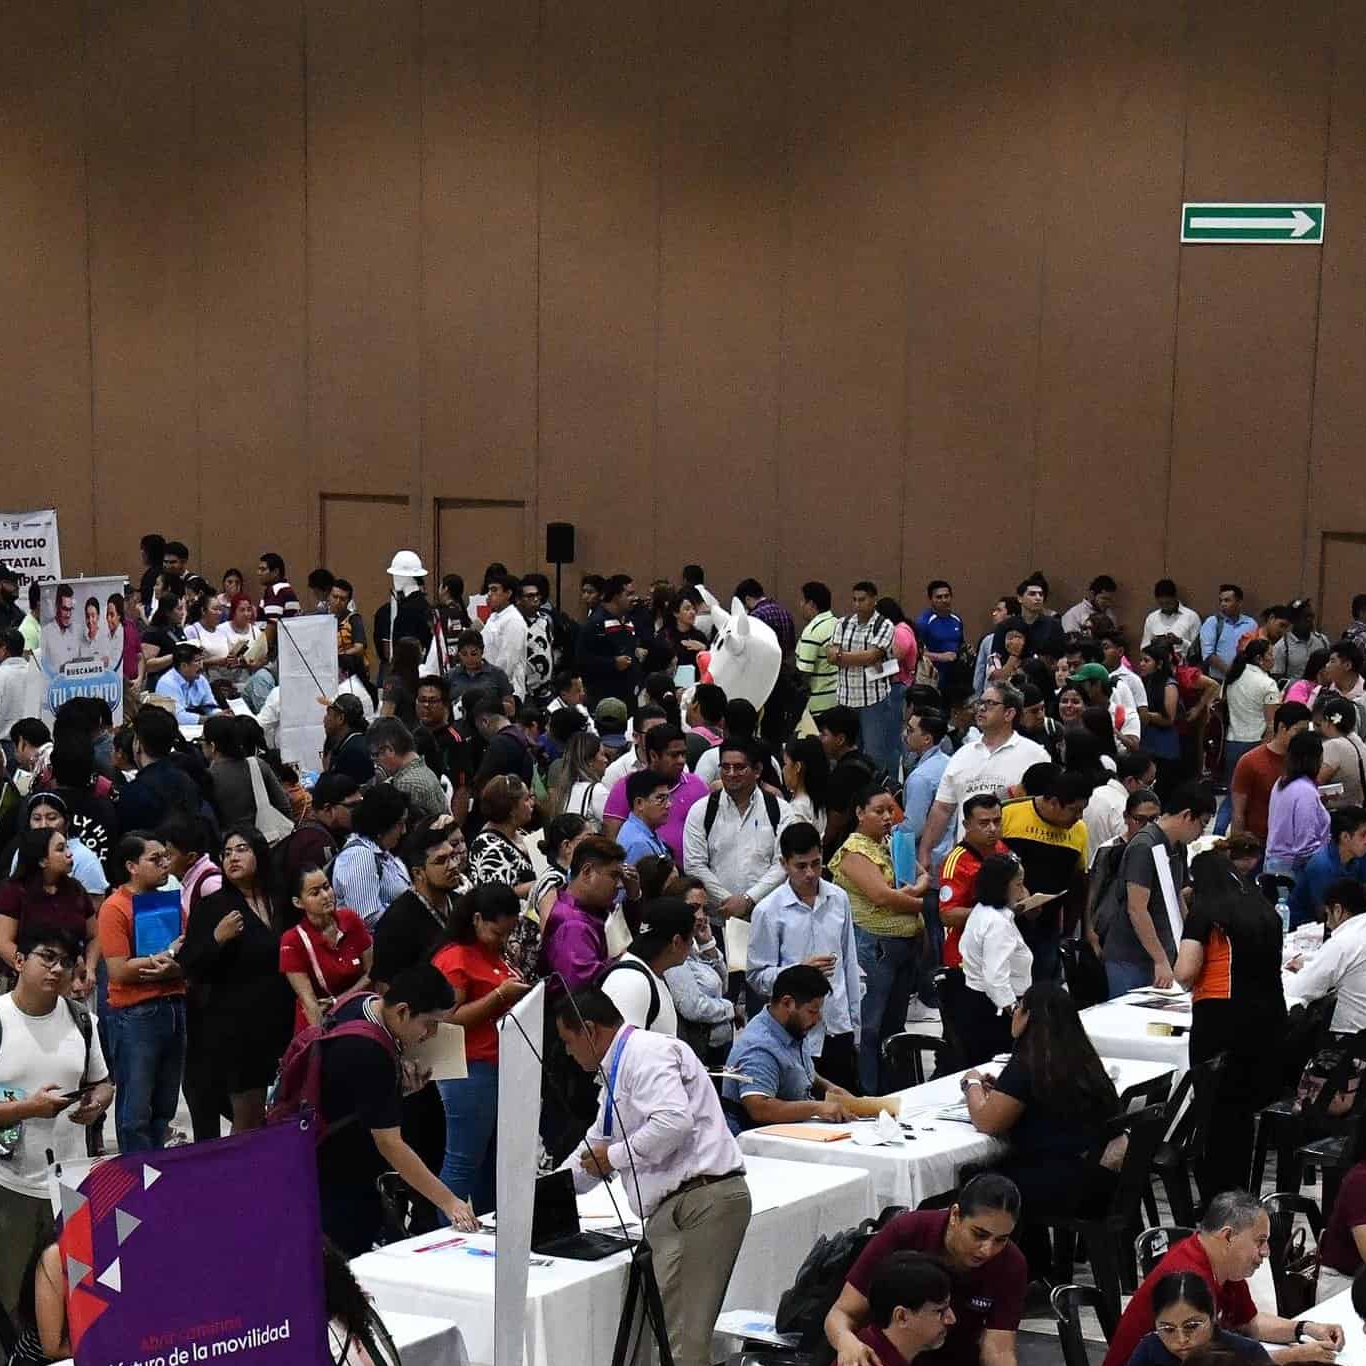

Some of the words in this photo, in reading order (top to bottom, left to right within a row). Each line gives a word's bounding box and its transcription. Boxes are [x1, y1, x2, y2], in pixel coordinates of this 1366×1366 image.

[168, 1347, 189, 1366] de
[192, 1343, 208, 1361] la
[212, 1319, 291, 1357] movilidad
